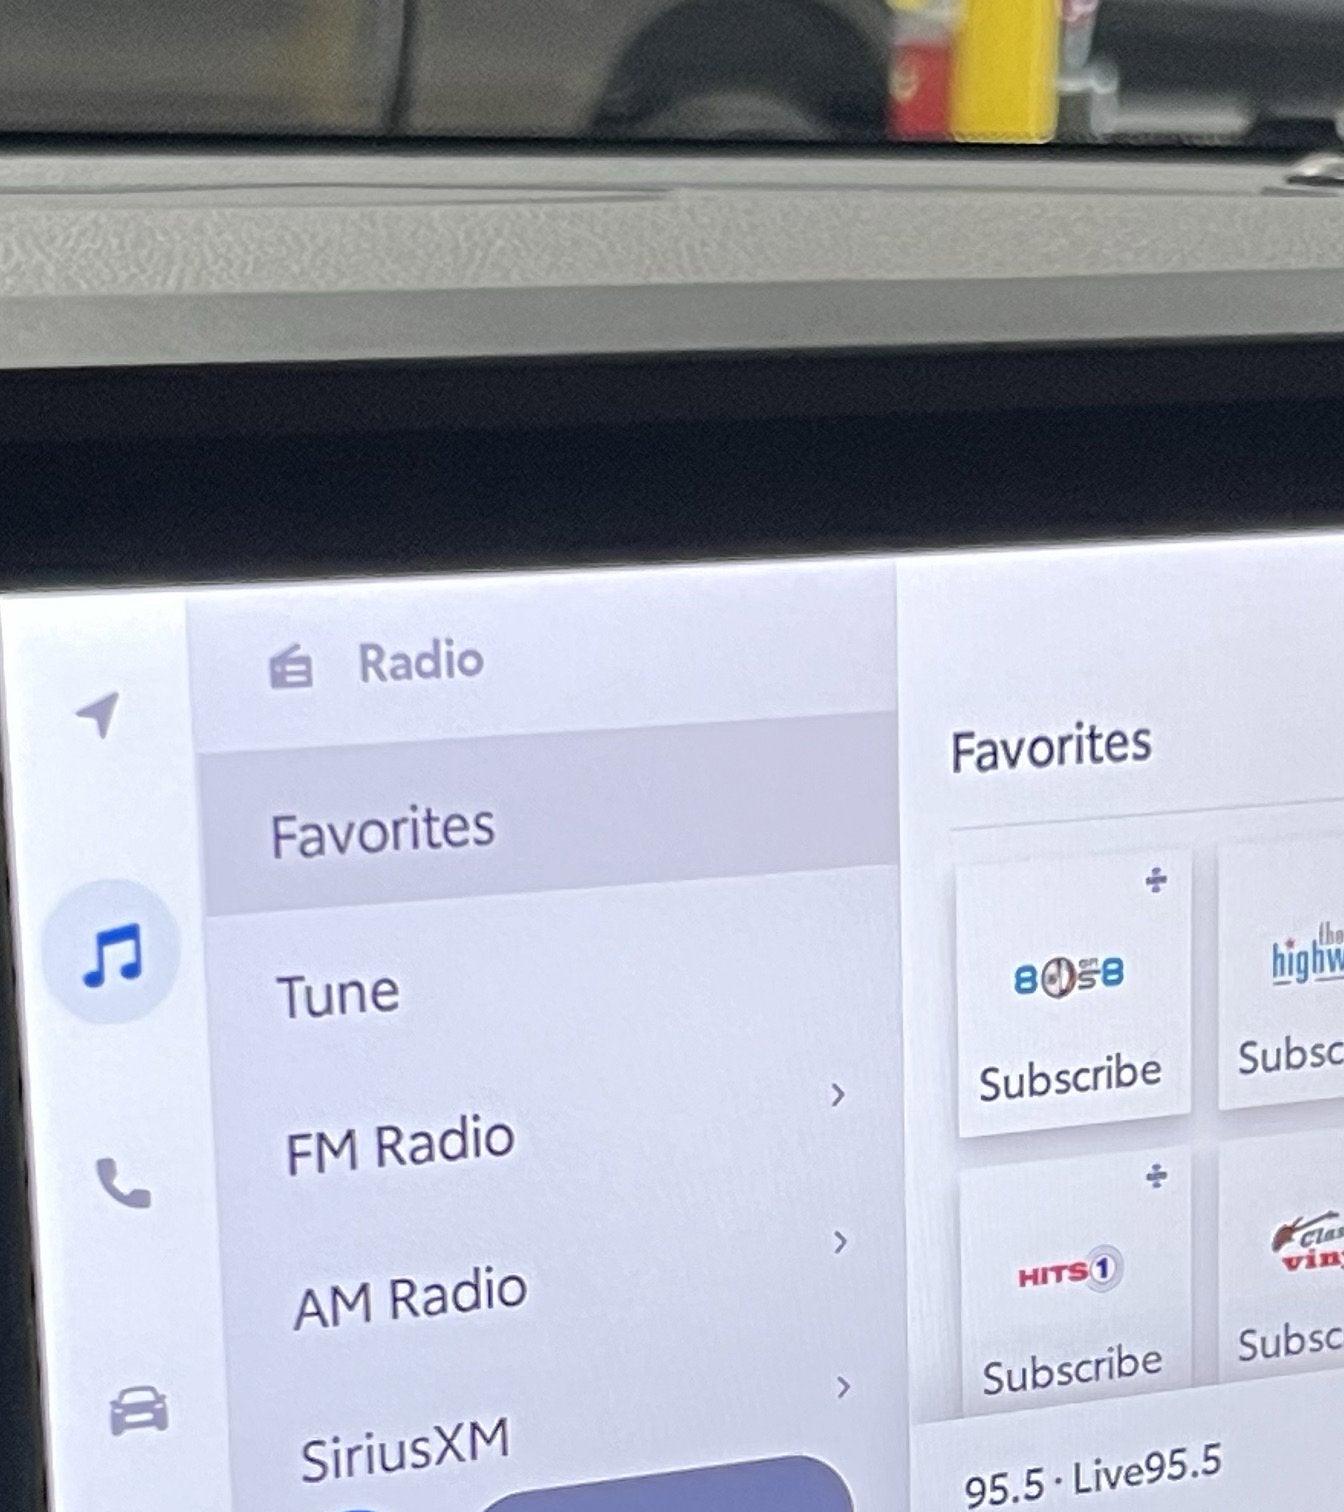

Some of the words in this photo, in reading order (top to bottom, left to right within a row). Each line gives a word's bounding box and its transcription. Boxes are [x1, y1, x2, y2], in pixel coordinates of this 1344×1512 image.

[359, 638, 485, 684] Radio
[951, 721, 1153, 773] Favorites
[271, 804, 496, 860] Favorites
[277, 974, 401, 1020] Tune
[978, 1053, 1163, 1103] Subscribe
[287, 1127, 359, 1176] FM
[376, 1115, 517, 1168] Radio
[293, 1282, 372, 1331] AM
[390, 1265, 529, 1320] Radio
[983, 1344, 1164, 1397] Subscribe
[300, 1417, 511, 1484] SiriusXM
[965, 1466, 1046, 1511] 95.5
[1073, 1442, 1223, 1497] Live95.5
